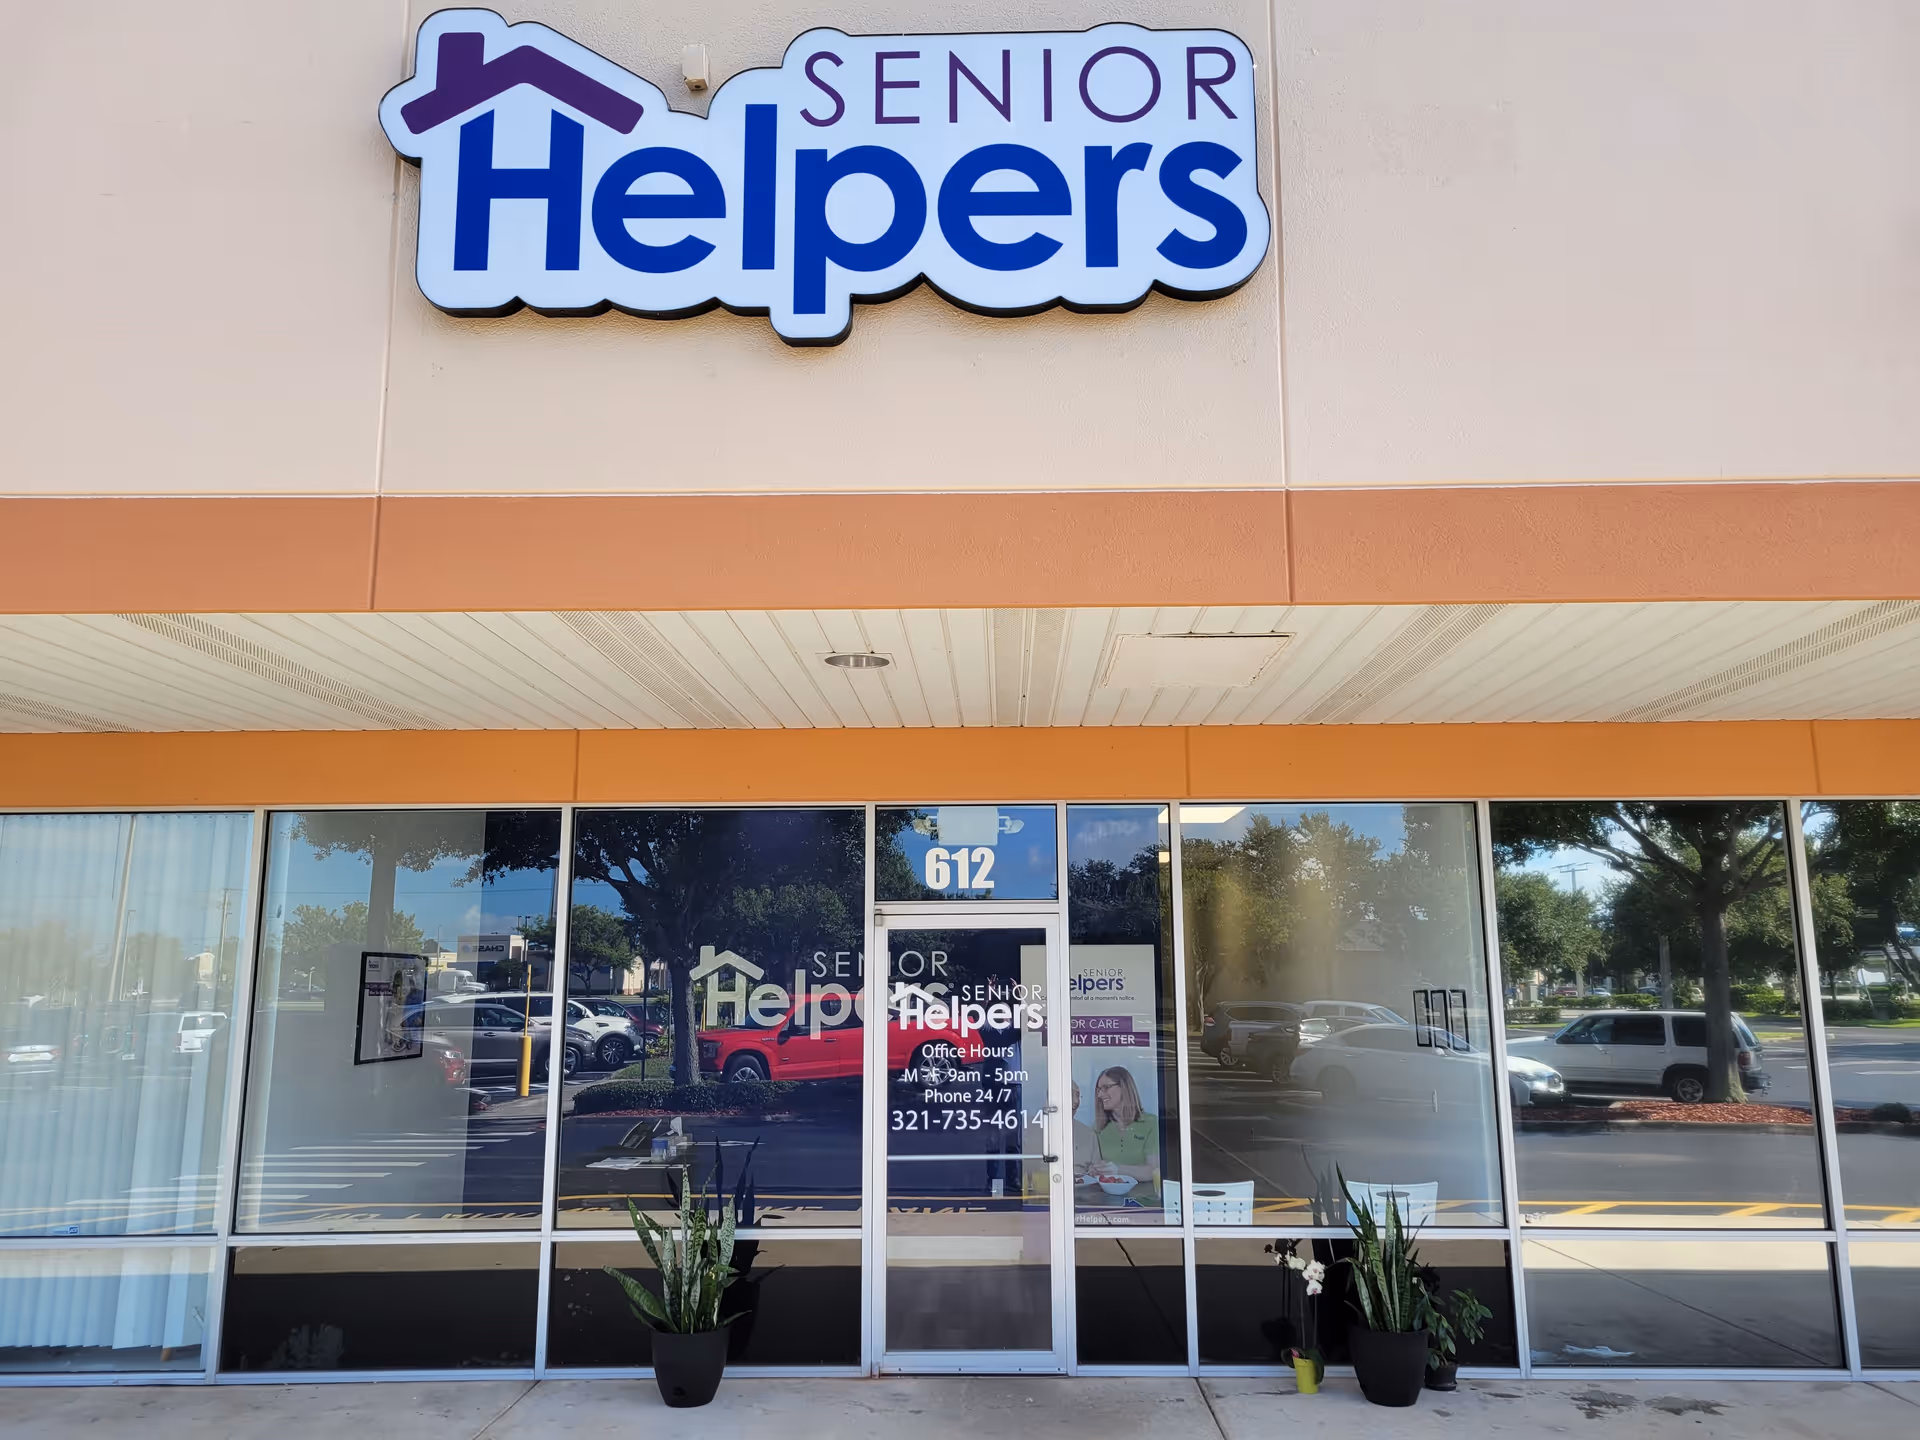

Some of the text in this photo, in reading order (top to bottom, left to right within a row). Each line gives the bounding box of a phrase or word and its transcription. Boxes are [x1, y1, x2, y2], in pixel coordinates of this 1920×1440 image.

[800, 47, 1239, 127] SENIOR
[453, 103, 1249, 315] Helpers
[925, 846, 995, 890] 612
[1083, 968, 1124, 977] SENIOR
[961, 984, 1042, 1001] SENIOR
[1070, 974, 1124, 995] elpers
[900, 995, 1044, 1038] Helpers
[1089, 1019, 1120, 1029] CARE
[1091, 1034, 1135, 1045] BETTER
[922, 1043, 1014, 1058] Office Hours
[904, 1068, 918, 1082] M
[948, 1068, 981, 1082] 9am
[994, 1067, 1029, 1085] 5pm
[925, 1088, 972, 1103] Phone
[891, 1109, 1044, 1130] 321-735-4614
